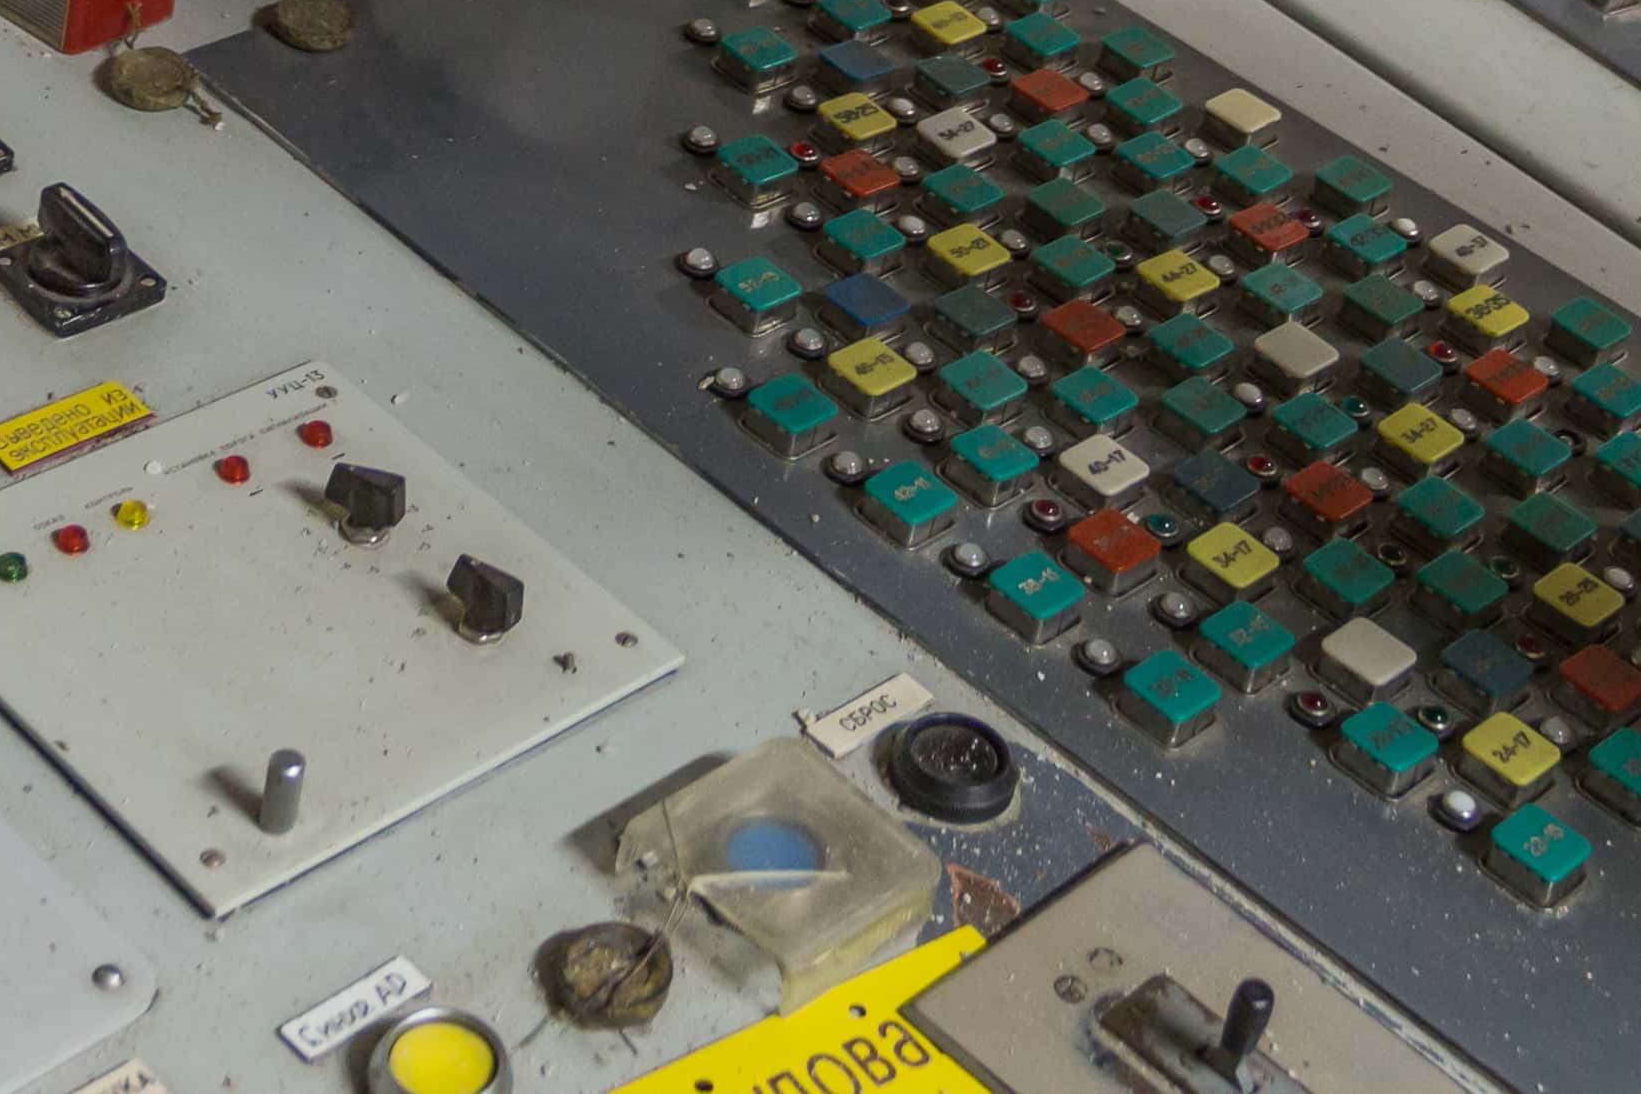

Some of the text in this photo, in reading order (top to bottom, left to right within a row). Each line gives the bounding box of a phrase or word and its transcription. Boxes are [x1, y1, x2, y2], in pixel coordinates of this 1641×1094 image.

[102, 388, 128, 408] из
[8, 402, 142, 462] эксплуатации
[839, 694, 897, 733] СБРОС
